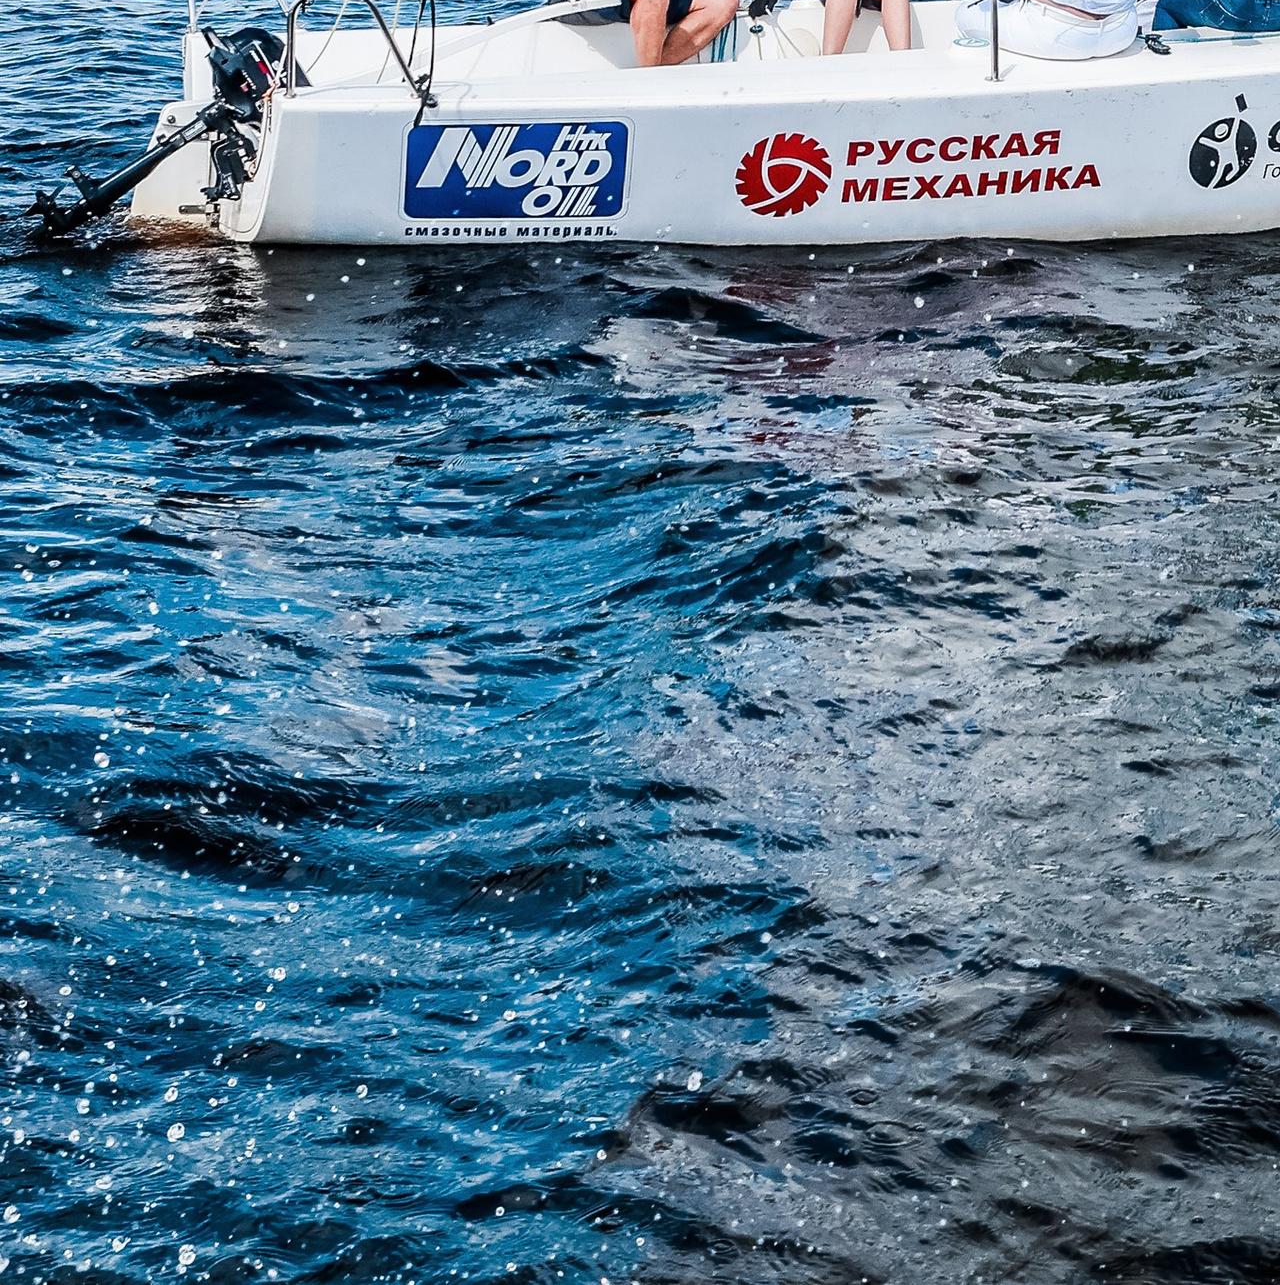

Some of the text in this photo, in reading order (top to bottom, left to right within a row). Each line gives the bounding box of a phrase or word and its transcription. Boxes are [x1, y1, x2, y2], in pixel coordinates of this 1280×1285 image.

[846, 129, 1062, 166] РУССКАЯ
[841, 164, 1102, 203] МЕХАНИКА
[521, 185, 600, 217] OIL
[404, 225, 507, 237] смазочные
